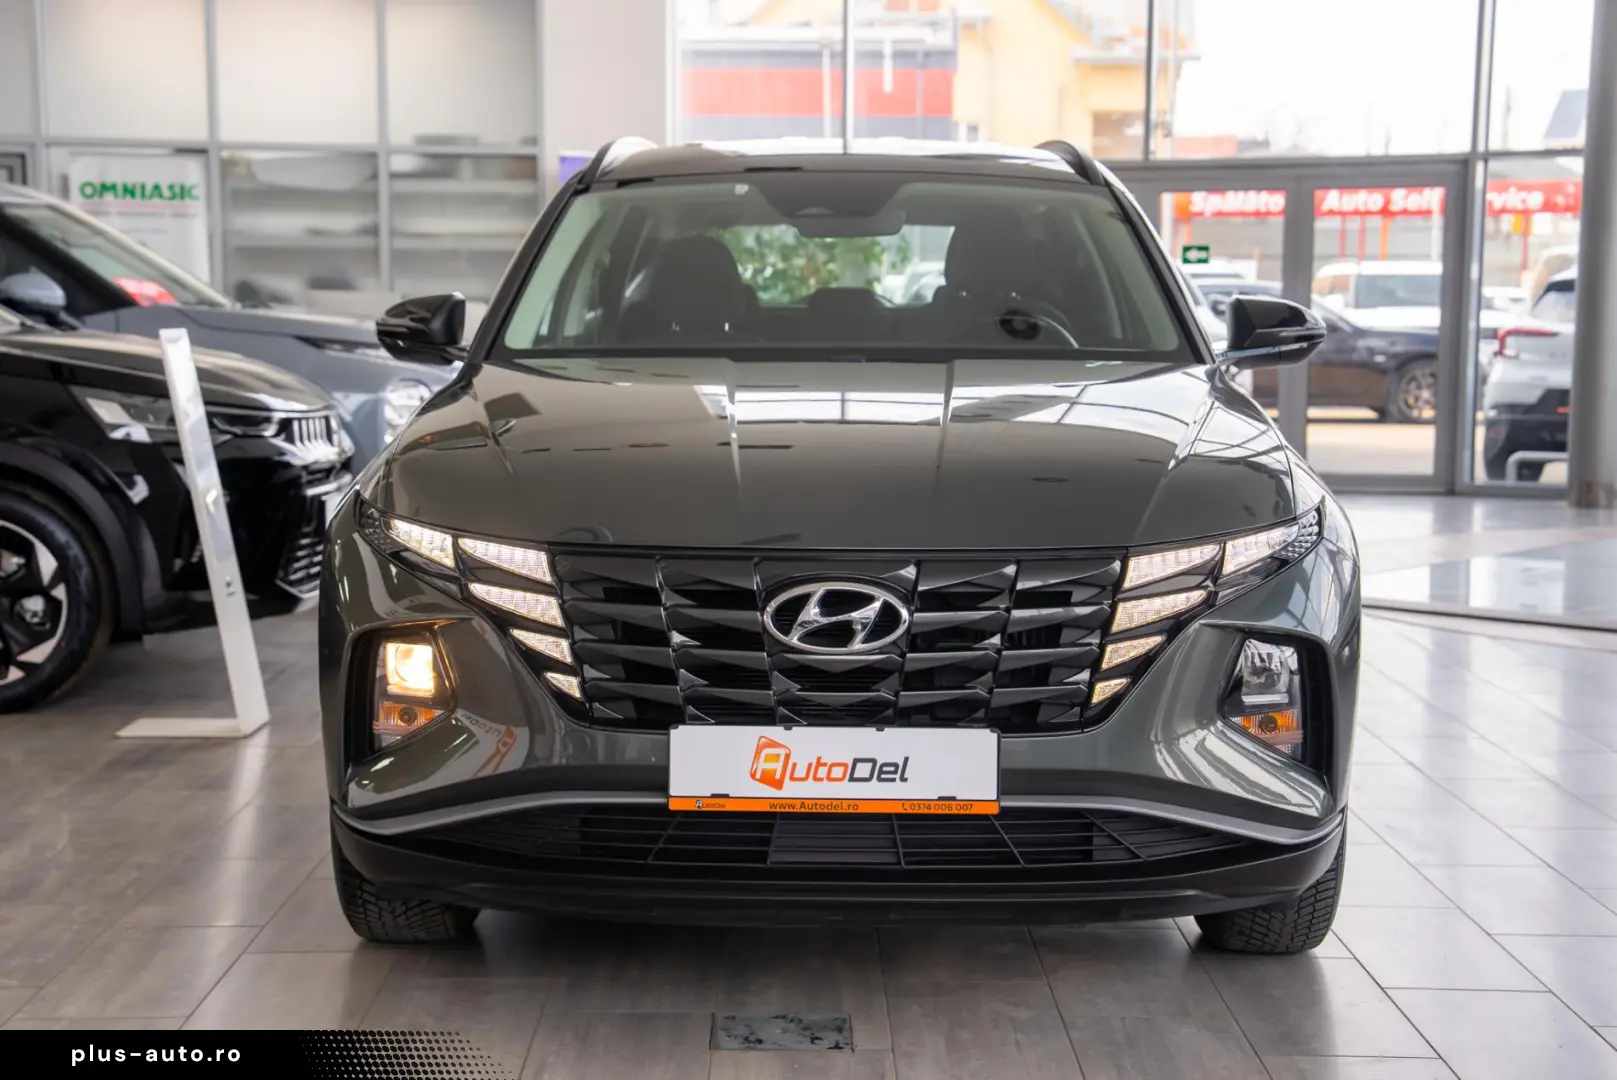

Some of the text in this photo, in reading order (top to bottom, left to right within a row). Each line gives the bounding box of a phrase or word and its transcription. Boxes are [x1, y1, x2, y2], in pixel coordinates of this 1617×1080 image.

[1320, 189, 1384, 213] Auto
[754, 748, 909, 783] AutoDel
[769, 802, 859, 811] www.Autodel.ro
[910, 803, 973, 812] 0374 006 007
